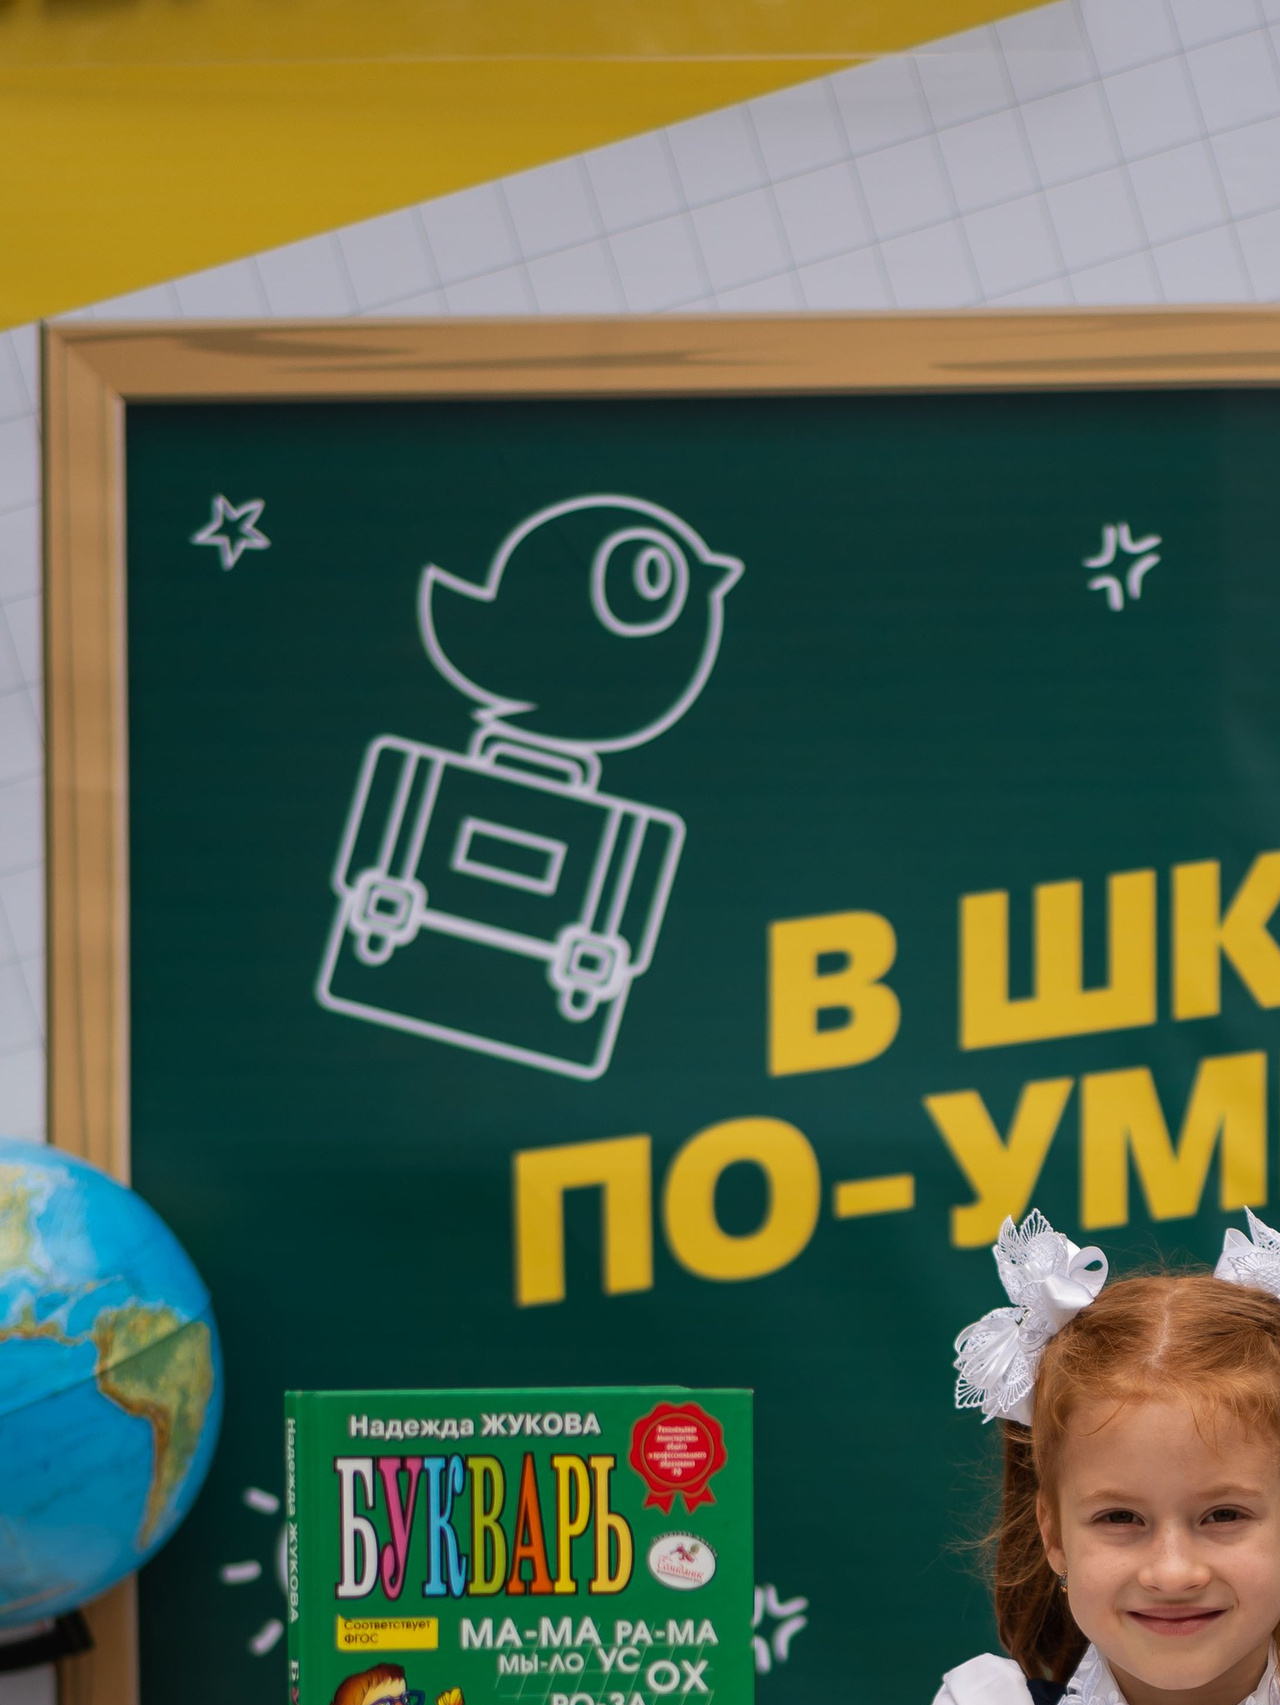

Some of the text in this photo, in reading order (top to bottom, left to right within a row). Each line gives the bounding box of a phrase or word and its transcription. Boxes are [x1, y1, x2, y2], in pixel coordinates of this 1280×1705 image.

[768, 909, 901, 1079] В
[350, 1412, 601, 1440] Надежда ЖУКОВА
[286, 1416, 297, 1517] Надежда
[333, 1452, 635, 1600] БУКВАРЬ
[288, 1521, 300, 1624] ЖУКОВА
[344, 1619, 431, 1632] Соответствует
[344, 1633, 379, 1645] ФГОС
[460, 1616, 720, 1649] МА-МА РА-МА
[498, 1647, 642, 1674] МЫ-ЛО УС
[645, 1659, 710, 1694] ОХ
